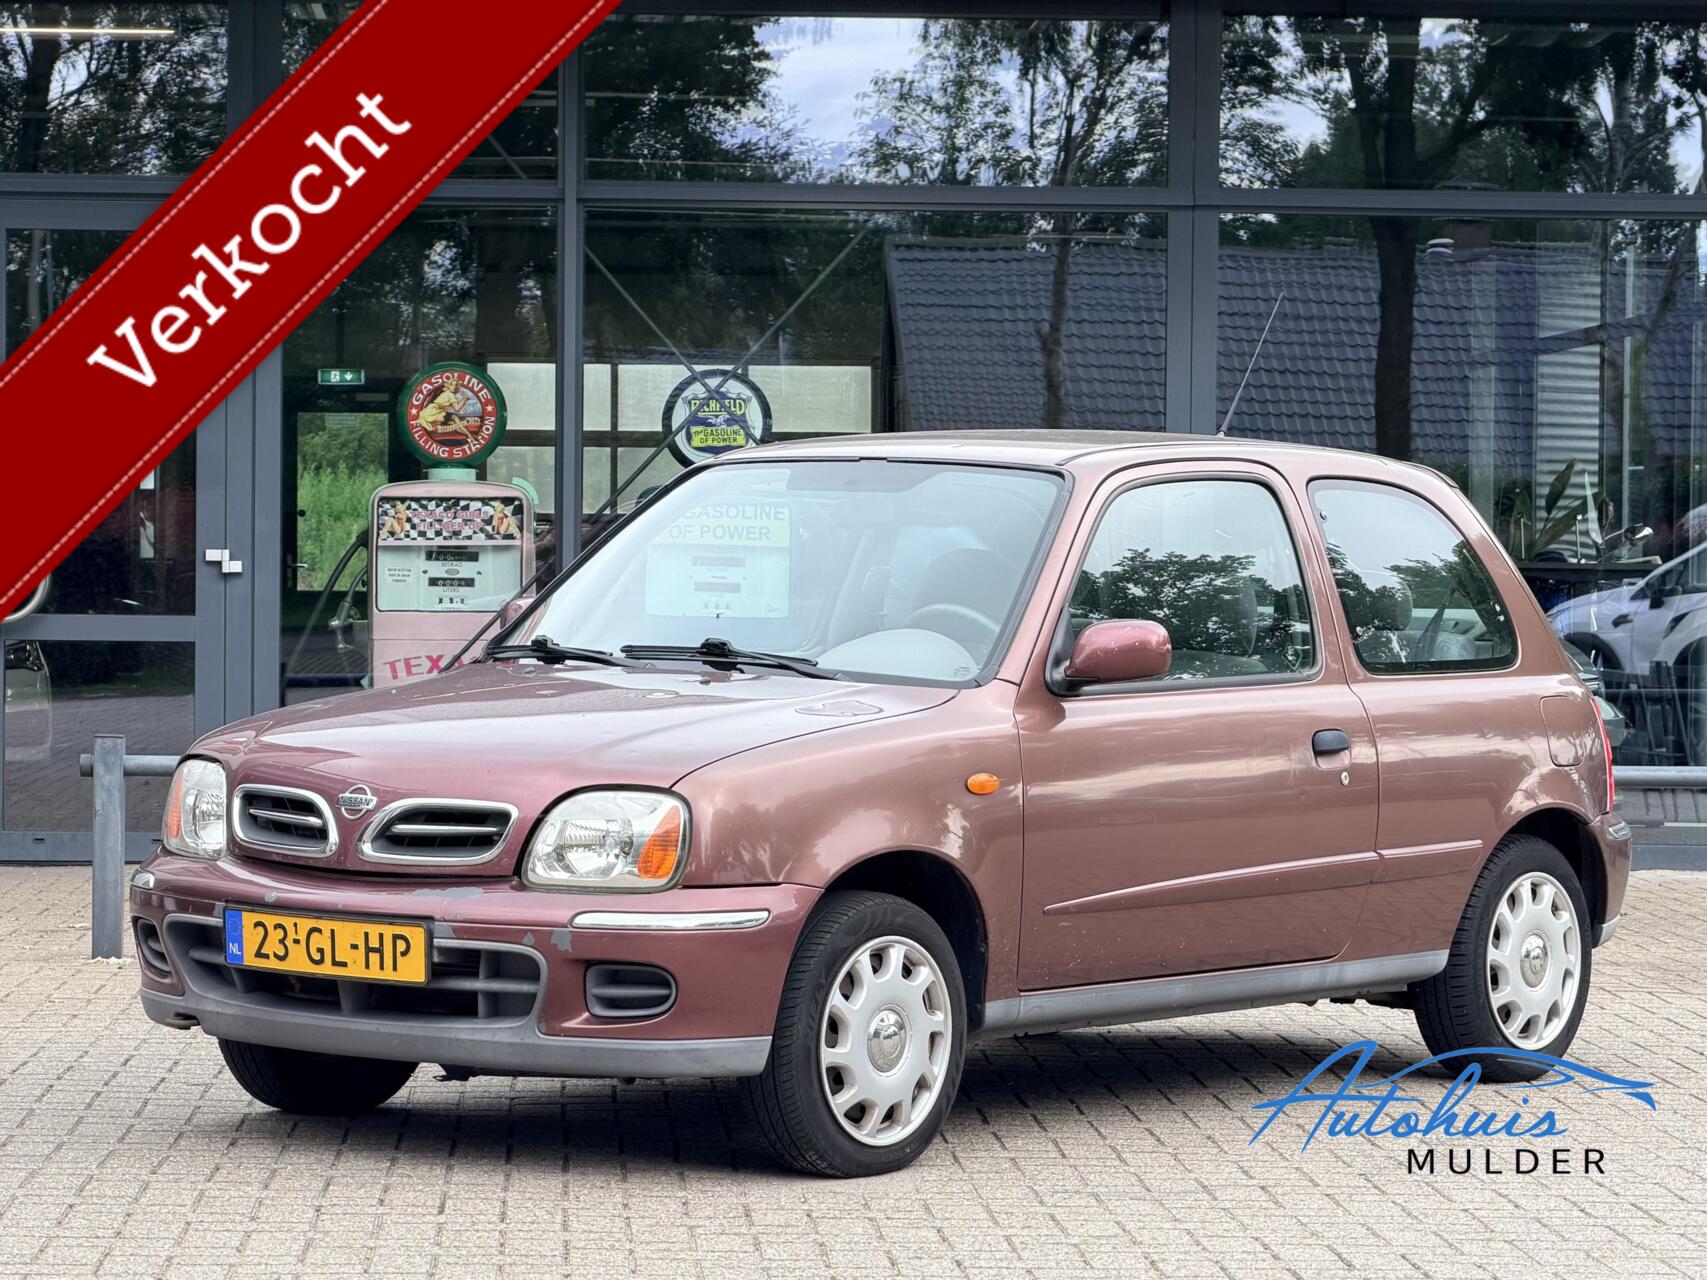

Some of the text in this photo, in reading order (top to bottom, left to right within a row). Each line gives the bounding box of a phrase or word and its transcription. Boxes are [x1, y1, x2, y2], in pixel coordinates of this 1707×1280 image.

[412, 372, 490, 405] GASOLINE
[411, 420, 449, 458] FILLING
[453, 416, 496, 459] STATION
[703, 428, 742, 438] GASOLINE
[410, 511, 490, 520] TEXACO GIRLS
[684, 504, 786, 521] GASOLINE
[416, 522, 439, 531] FILL
[669, 524, 771, 541] OF POWER
[339, 795, 373, 808] NISSAN
[229, 942, 242, 956] NL
